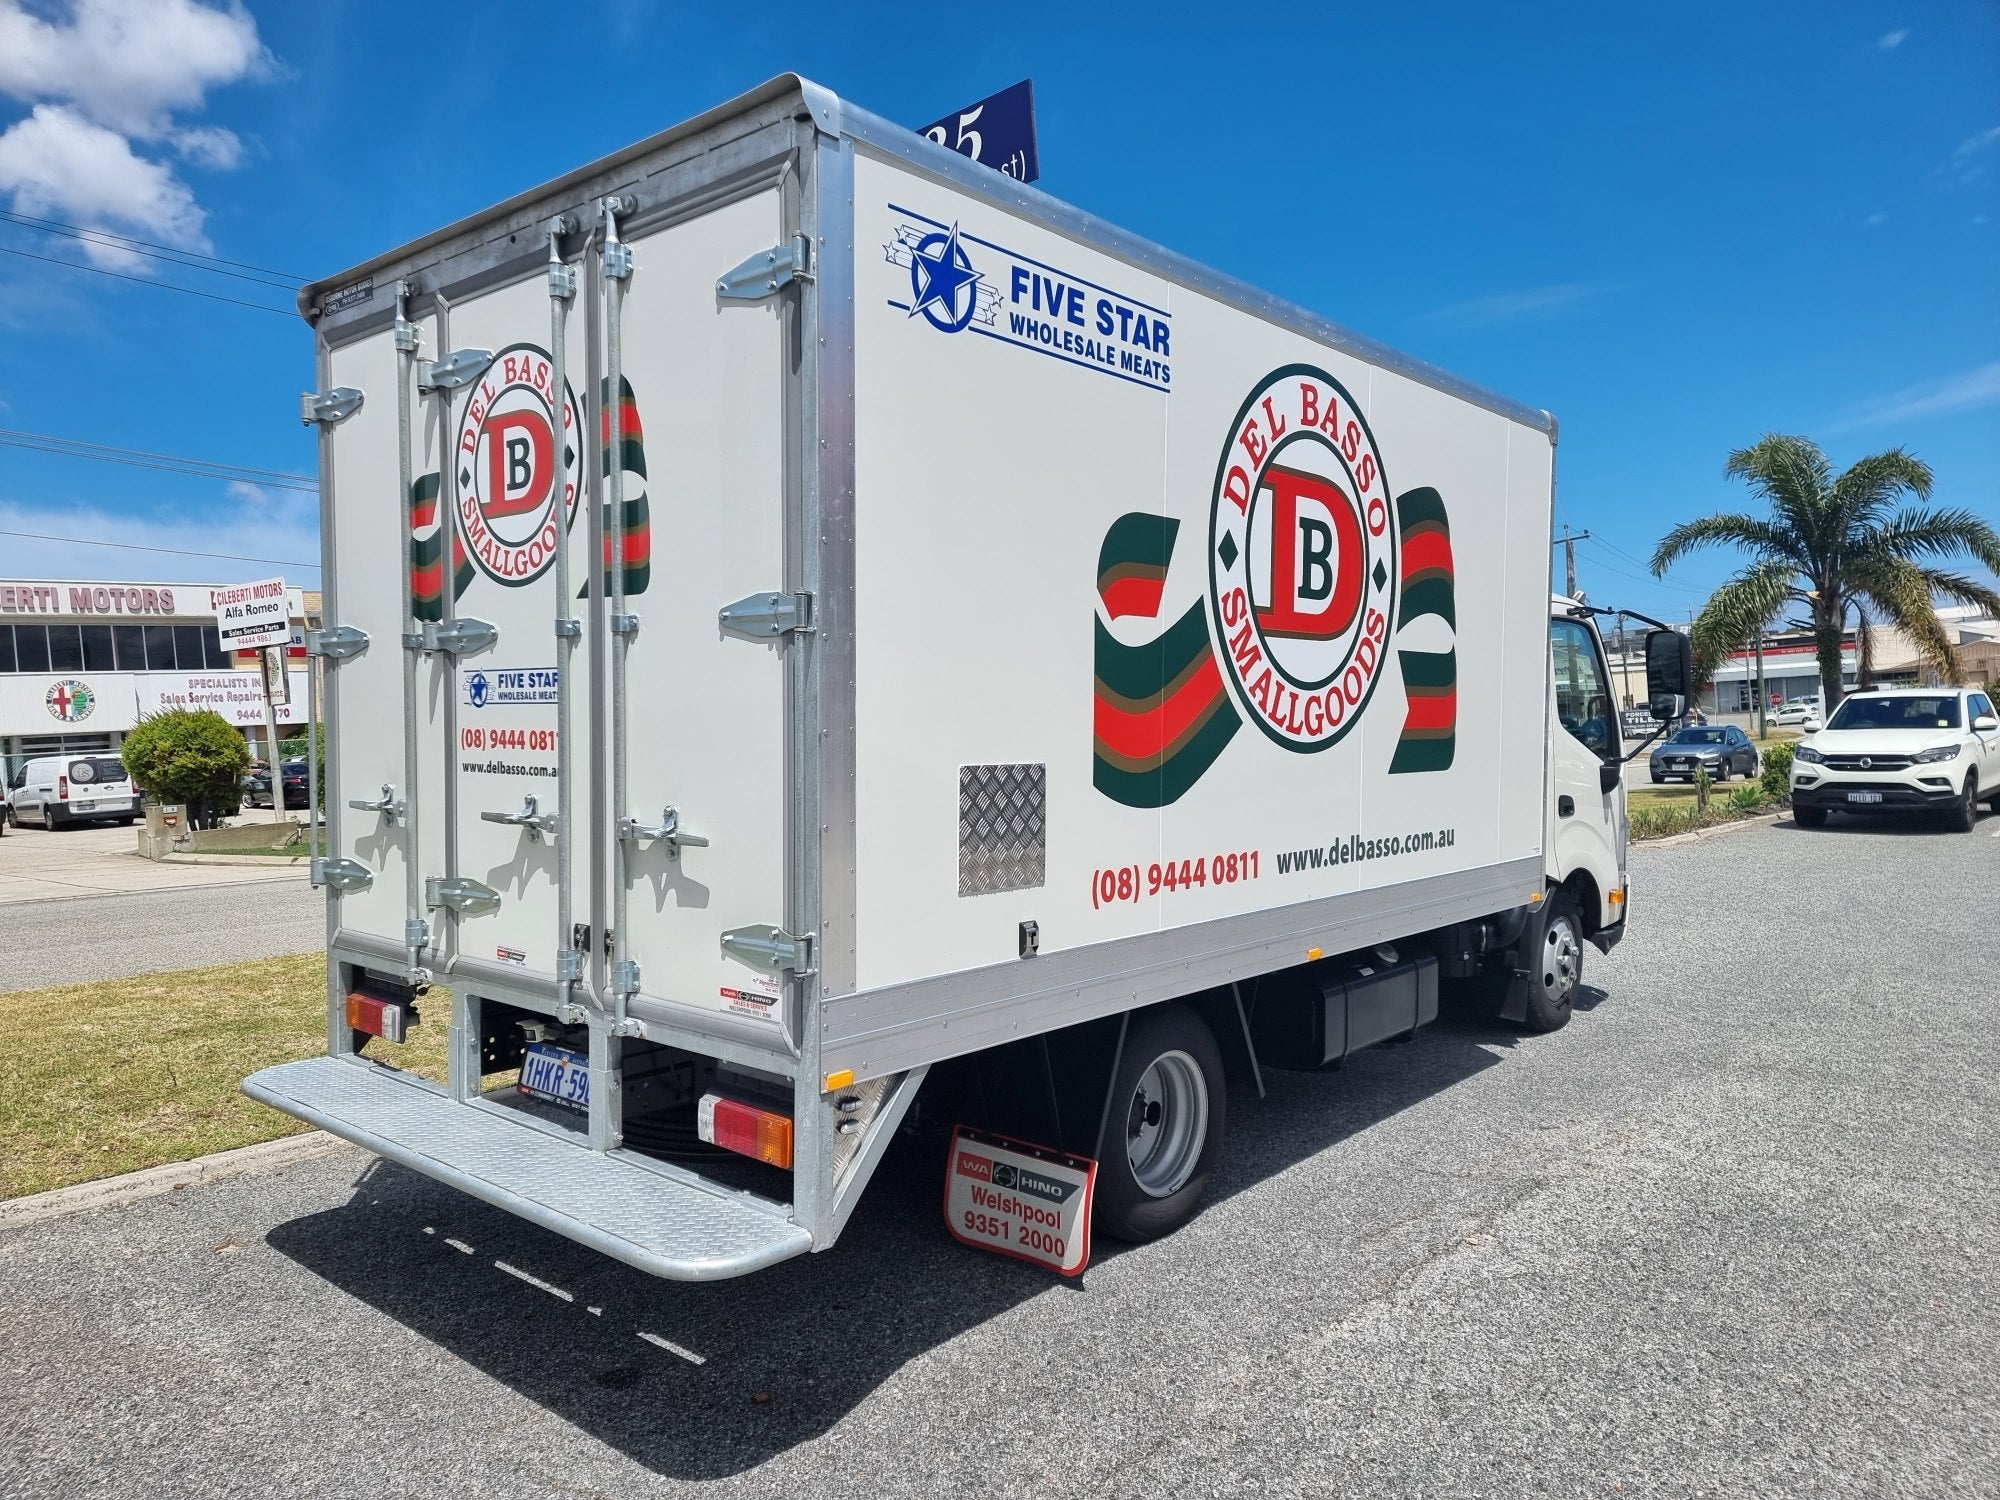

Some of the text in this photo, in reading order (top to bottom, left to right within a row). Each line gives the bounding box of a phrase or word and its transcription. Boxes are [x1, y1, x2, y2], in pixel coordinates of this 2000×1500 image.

[994, 149, 1026, 181] st)
[1011, 264, 1170, 357] FIVE STAR
[1009, 311, 1171, 384] WHOLESALE MEATS
[461, 381, 496, 456] DEL
[505, 437, 531, 492] B
[1223, 382, 1386, 538] DEL BASSO
[462, 484, 574, 577] SMALLGOOS
[1256, 462, 1364, 642] D
[1297, 516, 1333, 601] B
[0, 586, 175, 613] ERTI MOTORS
[217, 588, 252, 606] CILEBERTI
[253, 581, 283, 599] MOTORS
[225, 603, 279, 620] Alfa Romeo
[228, 623, 280, 637] Sales Service Parts
[1220, 586, 1386, 737] SMALLGOODS
[160, 691, 262, 704] Sales Service Repairs
[188, 678, 262, 689] SPECIALISTS IN
[498, 673, 525, 689] FIVE
[498, 691, 537, 700] WHOLESALE
[237, 709, 262, 720] 9444
[461, 728, 486, 751] (08)
[489, 729, 526, 750] 9444
[462, 760, 559, 778] www.delbasso.com.a
[1276, 827, 1455, 875] www.delbasso.com.au
[1091, 850, 1259, 910] (08) 9444 0811
[722, 989, 772, 1004] WA HINO
[963, 1159, 1063, 1197] WA HINO
[971, 1184, 1061, 1230] Welshpool
[964, 1210, 1065, 1258] 9351 2000
